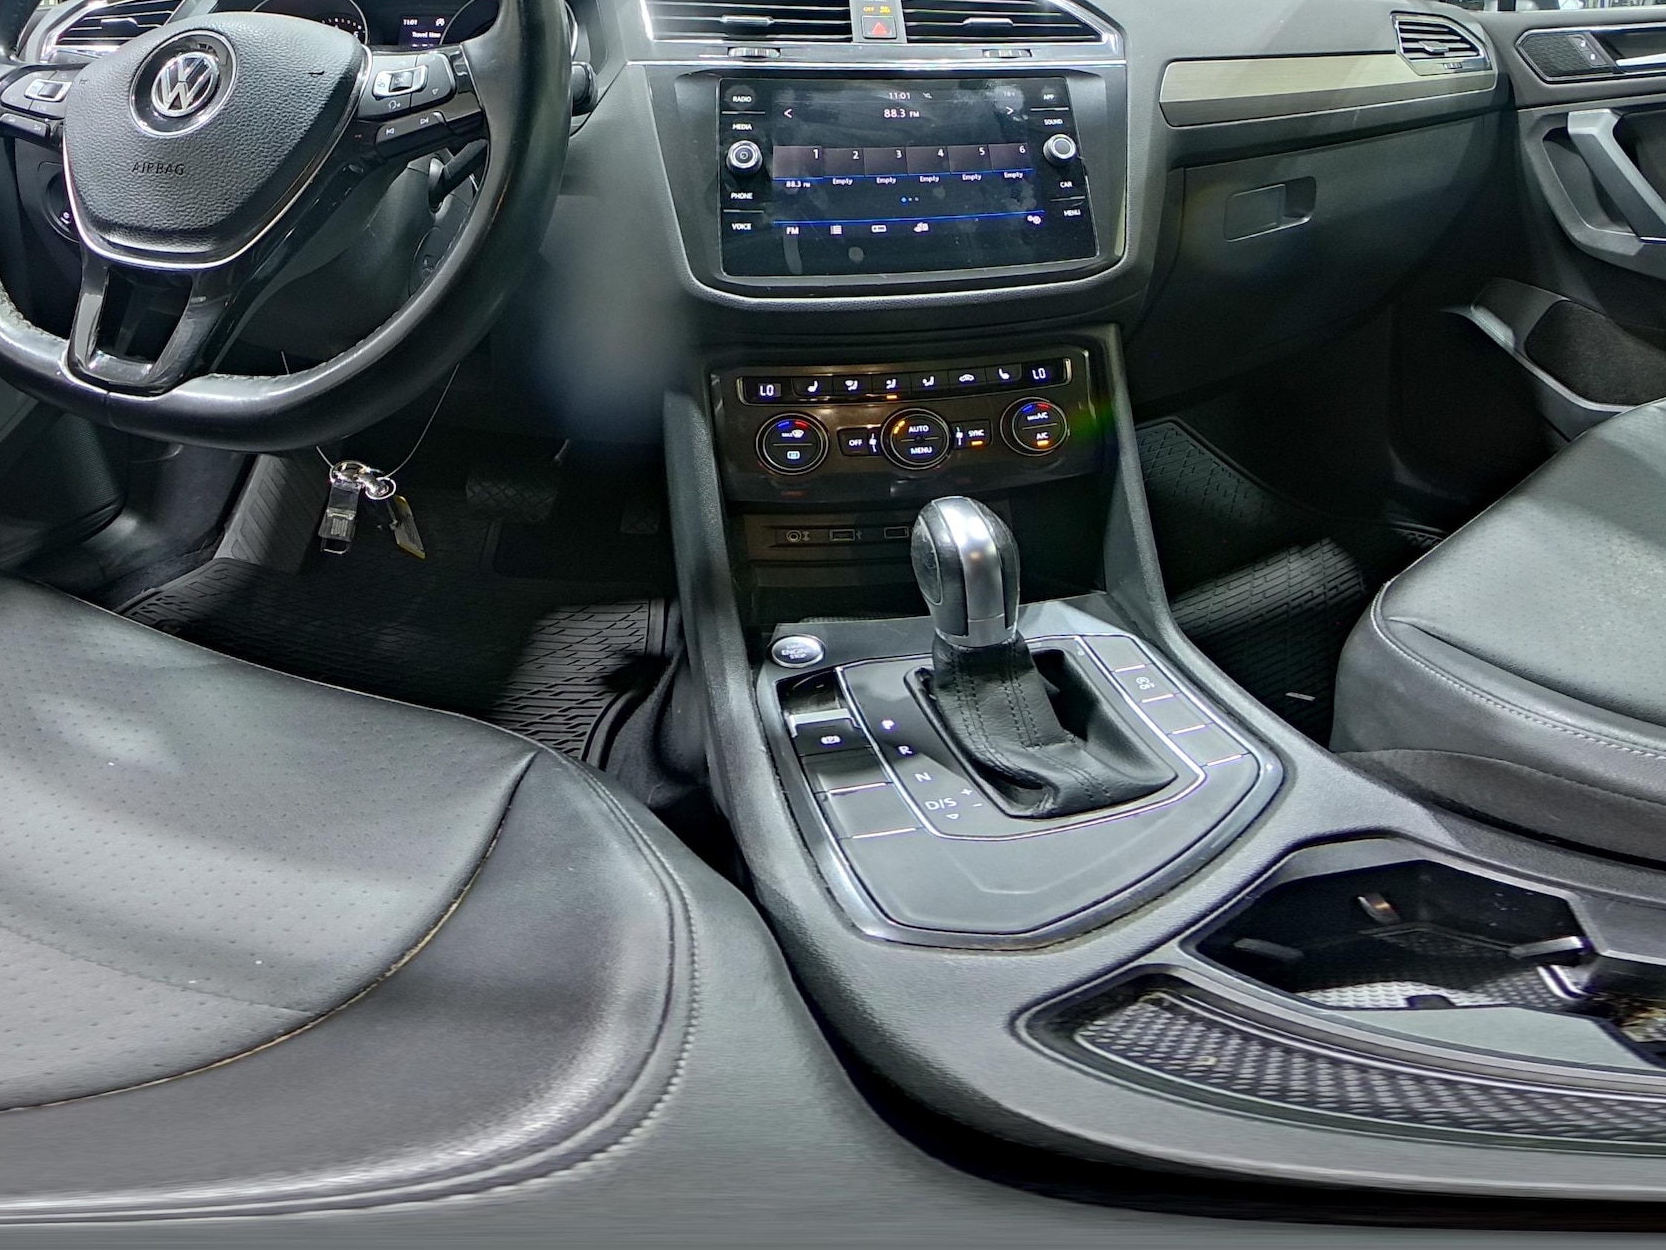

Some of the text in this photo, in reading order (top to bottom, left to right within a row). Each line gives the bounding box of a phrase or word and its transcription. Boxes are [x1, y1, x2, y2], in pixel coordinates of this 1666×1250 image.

[888, 92, 911, 100] 11:01
[884, 109, 920, 118] 88.3 FM
[813, 146, 1026, 160] 1 2 3 4 5 6
[131, 162, 185, 176] AIRBAG
[833, 178, 853, 186] Empty
[877, 176, 897, 184] Empty
[919, 175, 939, 183] Empty
[962, 174, 982, 182] Empty
[1003, 172, 1024, 180] Empty
[731, 192, 753, 200] PHONE
[787, 226, 799, 234] FM
[1032, 367, 1047, 380] LO
[759, 384, 775, 396] LO
[908, 424, 929, 433] AUTO
[1036, 432, 1049, 440] A/C
[849, 438, 863, 446] OFF
[1139, 682, 1155, 690] OFF
[882, 720, 895, 730] P
[899, 746, 913, 755] R
[915, 772, 932, 782] N
[925, 798, 958, 810] D/S
